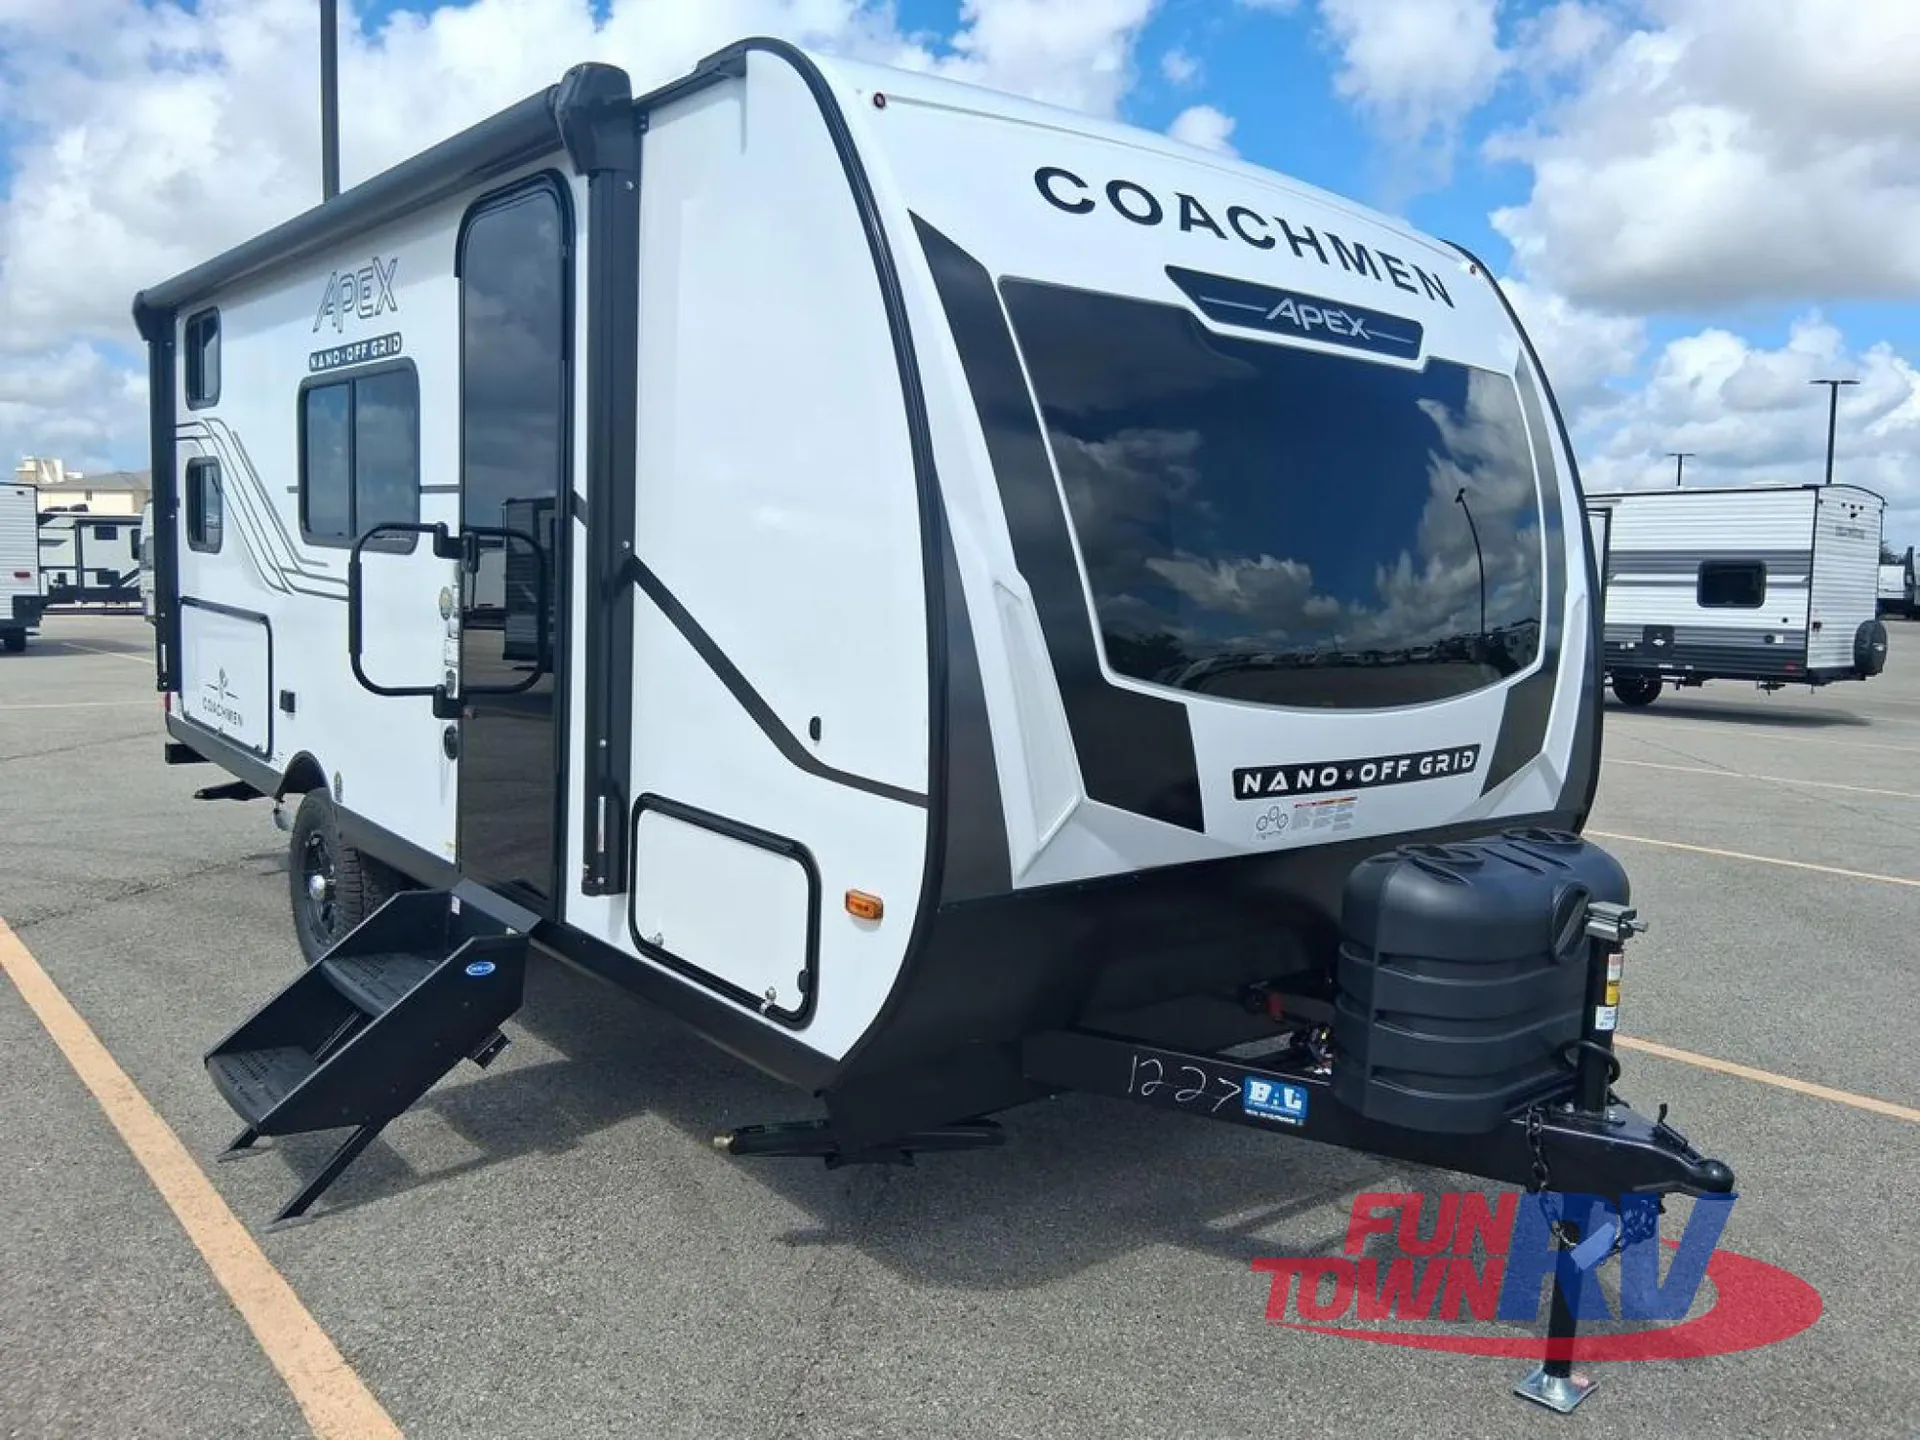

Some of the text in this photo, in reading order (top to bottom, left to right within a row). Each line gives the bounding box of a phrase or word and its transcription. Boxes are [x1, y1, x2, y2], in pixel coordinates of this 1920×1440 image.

[1033, 165, 1457, 309] COACHMEN
[312, 256, 399, 334] APEX
[1265, 297, 1371, 341] APEX
[370, 335, 400, 357] GRID
[1418, 750, 1476, 776] GRID
[1127, 1055, 1242, 1113] 1227
